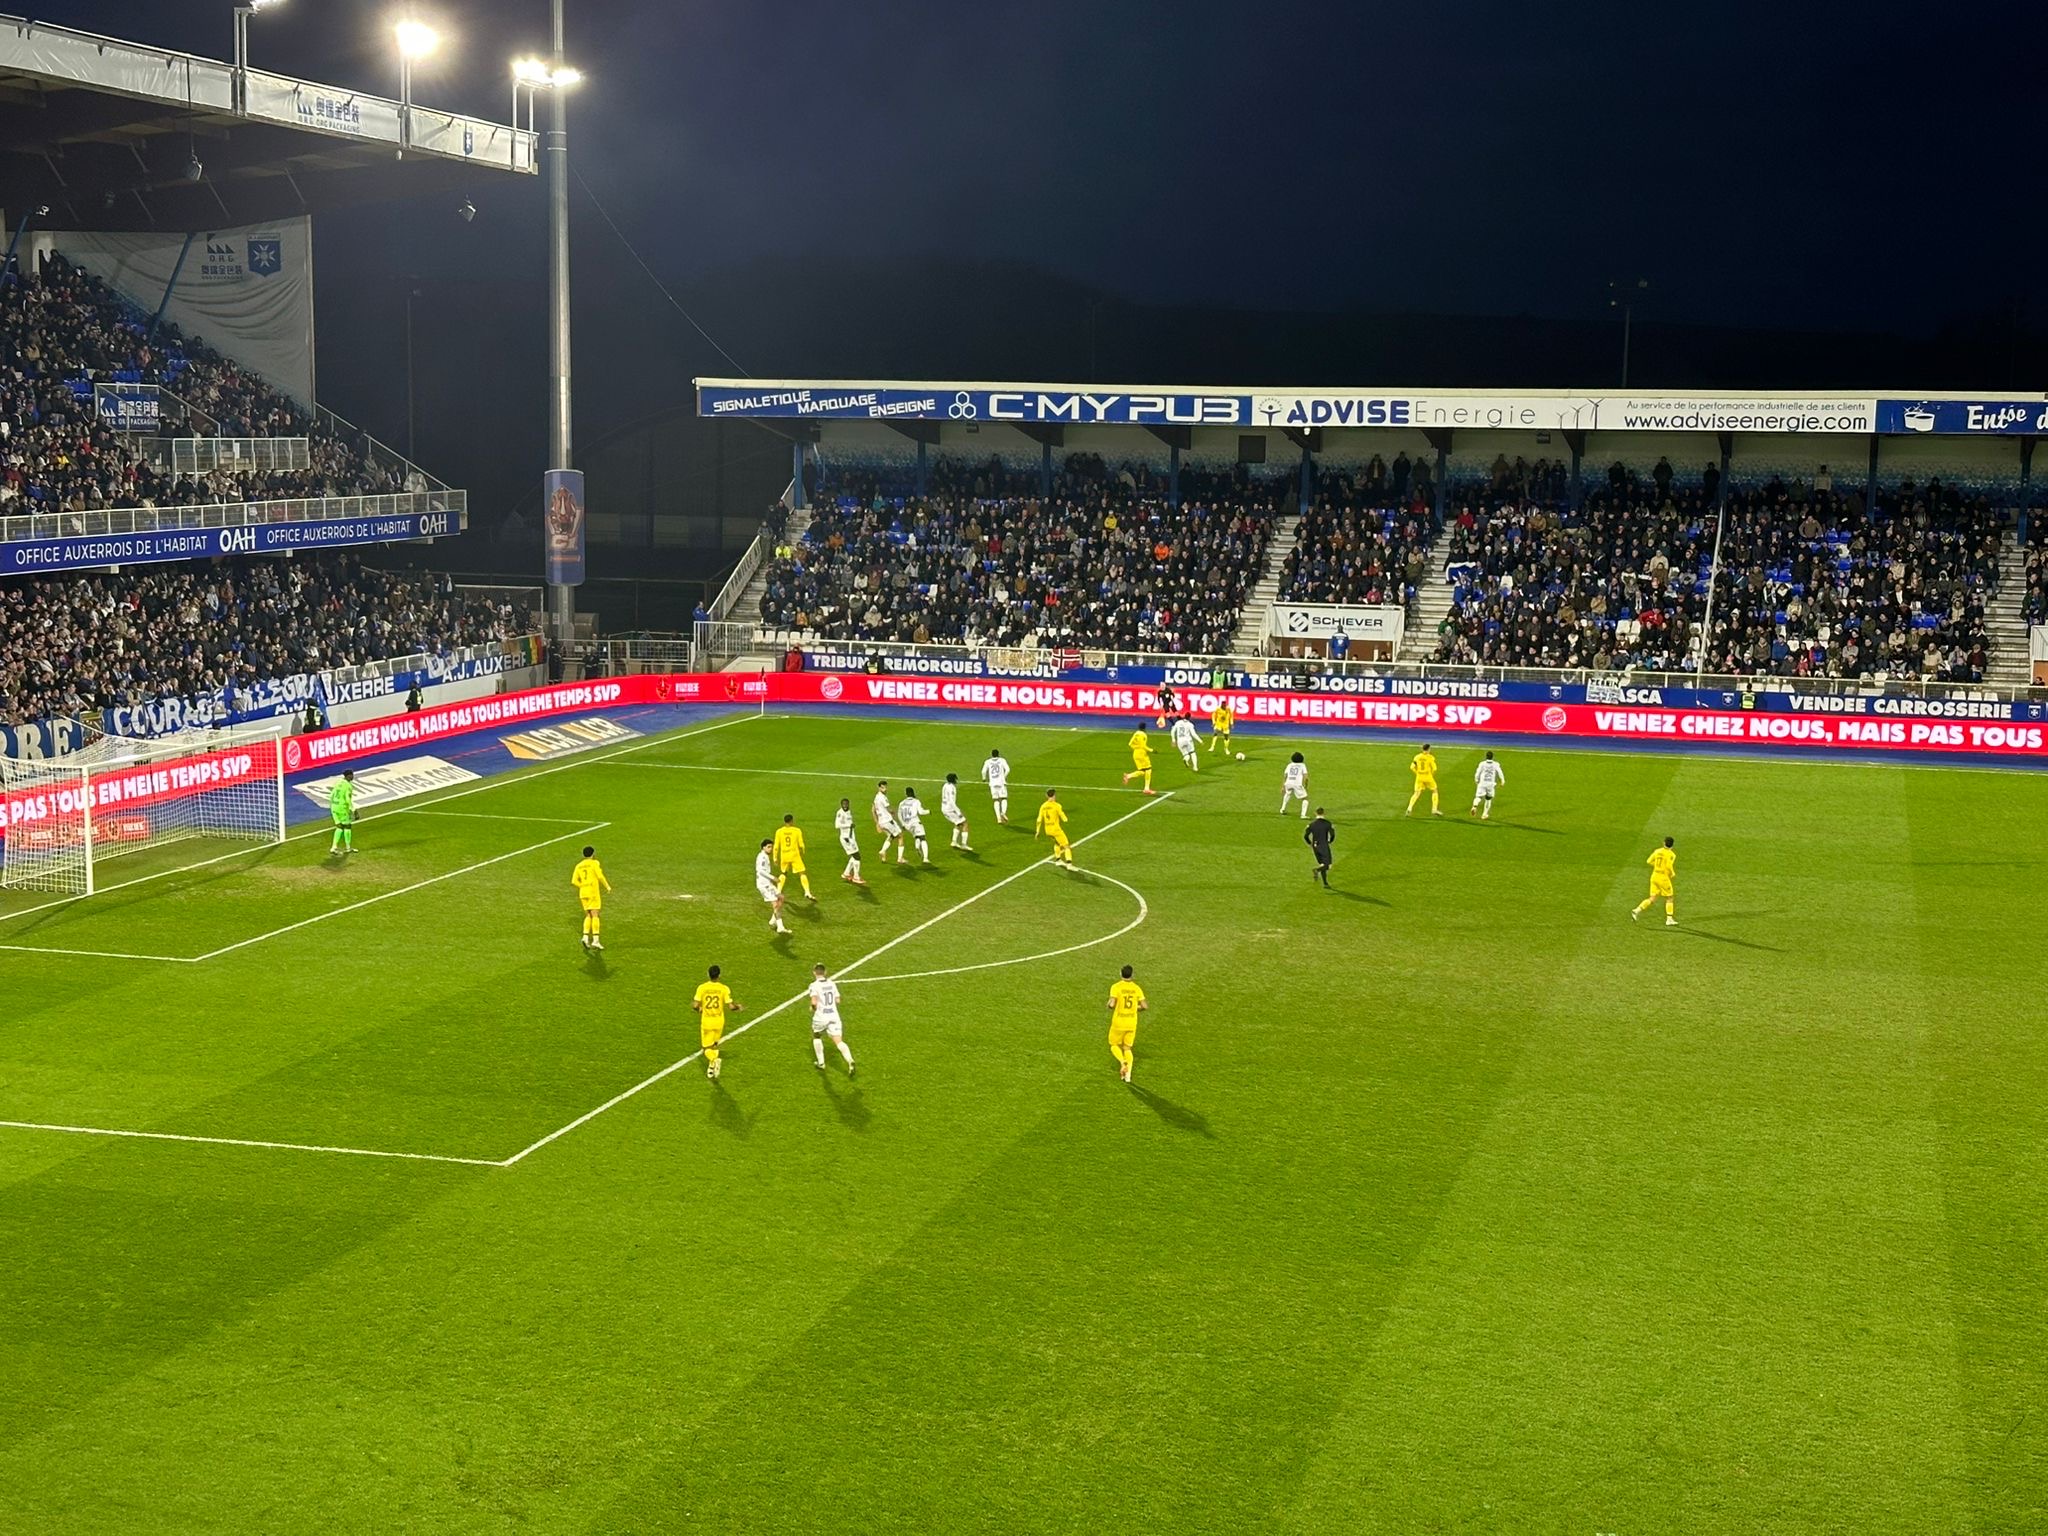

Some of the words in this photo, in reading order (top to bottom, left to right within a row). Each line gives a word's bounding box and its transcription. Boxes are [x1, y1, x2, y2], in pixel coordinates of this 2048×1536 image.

[713, 390, 811, 413] SIGNALETIQUE
[797, 393, 877, 414] MARQUAGE
[868, 399, 935, 417] ENSEIGNE
[989, 394, 1120, 420] C-MY
[1129, 396, 1240, 422] PUB
[1641, 402, 1671, 410] service
[1674, 401, 1686, 410] de
[1688, 401, 1697, 410] la
[1699, 402, 1755, 412] performance
[1757, 402, 1804, 411] industrielle
[1806, 403, 1818, 411] de
[1837, 403, 1865, 411] clients
[1287, 400, 1410, 424] ADVISE
[1415, 401, 1536, 428] Energie
[1624, 412, 1867, 431] www.adviseenergie.com
[16, 546, 60, 565] OFFICE
[64, 541, 132, 561] AUXERROIS
[136, 540, 151, 555] DE
[156, 535, 207, 554] L'HABITAT
[219, 527, 256, 552] OAH
[267, 529, 300, 544] OFFICE
[303, 525, 354, 542] AUXERROIS
[356, 524, 368, 537] DE
[371, 520, 411, 536] L'HABITAT
[419, 514, 447, 535] OAH
[1312, 616, 1383, 627] SCHIEVER
[884, 658, 982, 675] REMORQUES
[1391, 679, 1499, 698] INDUSTRIES
[868, 680, 938, 700] VENEZ
[942, 684, 997, 702] CHEZ
[1001, 687, 1072, 708] NOUS,
[1077, 689, 1134, 709] MAIS
[1254, 697, 1286, 715] EN
[1290, 698, 1357, 719] MEME
[1361, 701, 1440, 723] TEMPS
[1444, 705, 1492, 725] SVP
[1790, 695, 1866, 712] VENDEE
[1873, 699, 2012, 719] CARROSSERIE
[309, 738, 349, 759] VENEZ
[350, 732, 379, 751] CHEZ
[381, 724, 419, 744] NOUS,
[420, 713, 449, 735] MAIS
[450, 708, 473, 728] PAS
[473, 701, 501, 723] TOUS
[502, 699, 518, 718] EN
[519, 692, 553, 714] MEME
[553, 686, 593, 708] TEMPS
[593, 683, 621, 702] SVP
[1595, 711, 1676, 733] VENEZ
[1681, 714, 1744, 737] CHEZ
[1750, 717, 1833, 742] NOUS,
[1838, 721, 1906, 743] MAIS
[1910, 724, 1964, 746] PAS
[1969, 726, 2043, 748] TOUS
[11, 795, 48, 824] PAS
[99, 780, 121, 805] EN
[170, 760, 220, 789] TEMPS
[222, 754, 251, 778] SVP
[705, 995, 720, 1010] 23
[823, 991, 834, 1006] 10
[1123, 996, 1133, 1010] 15
